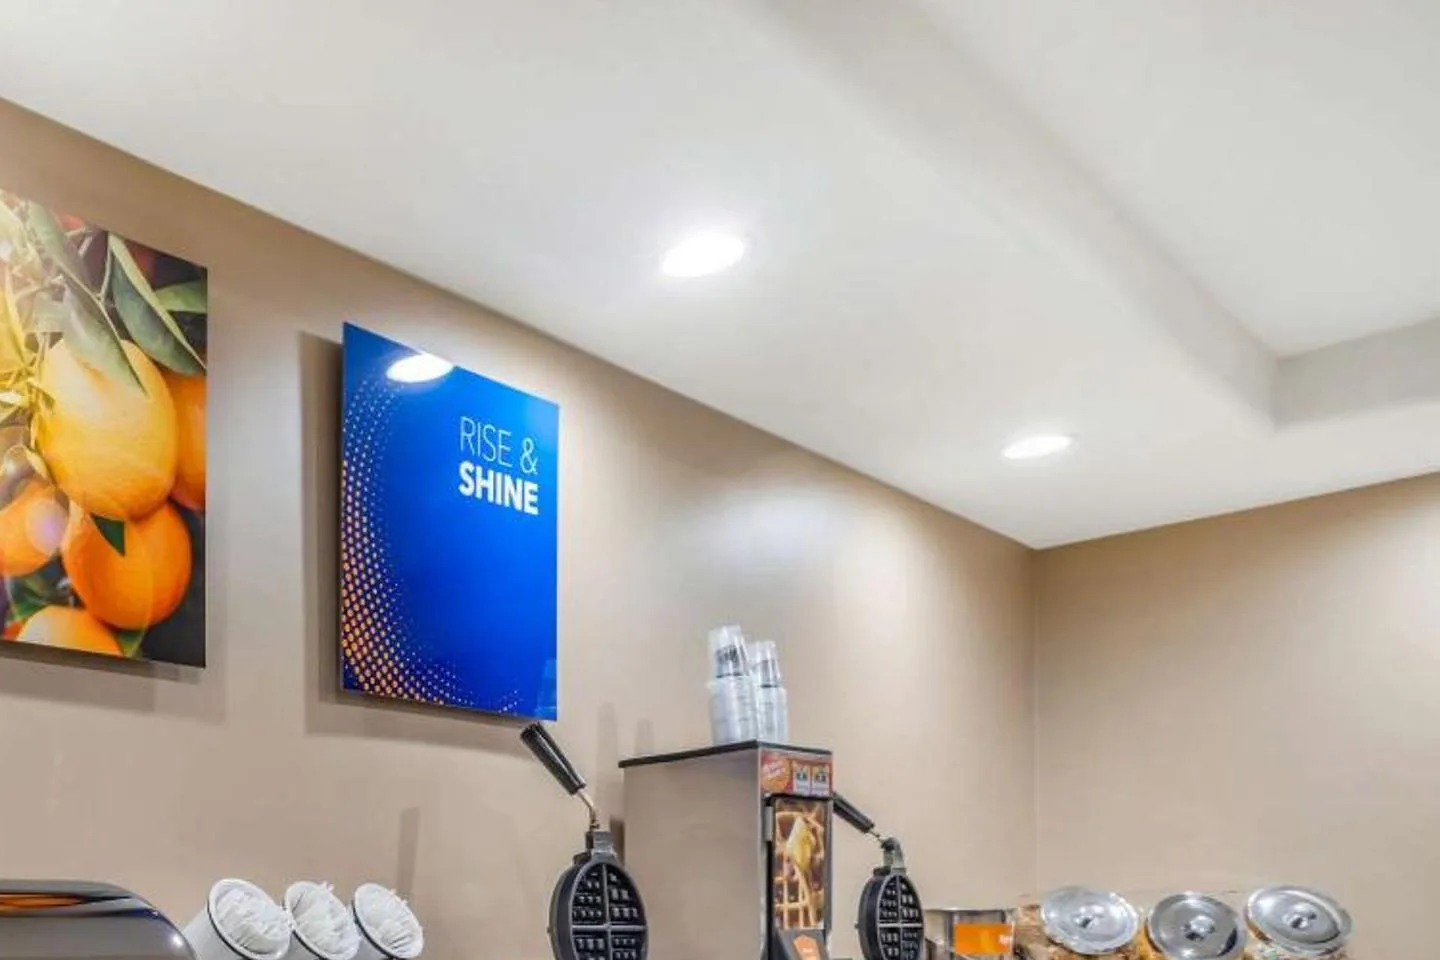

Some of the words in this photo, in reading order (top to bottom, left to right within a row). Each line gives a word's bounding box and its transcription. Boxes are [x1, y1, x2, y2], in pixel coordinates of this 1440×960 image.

[460, 416, 512, 467] RISE
[520, 437, 538, 475] &
[458, 460, 539, 515] SHINE
